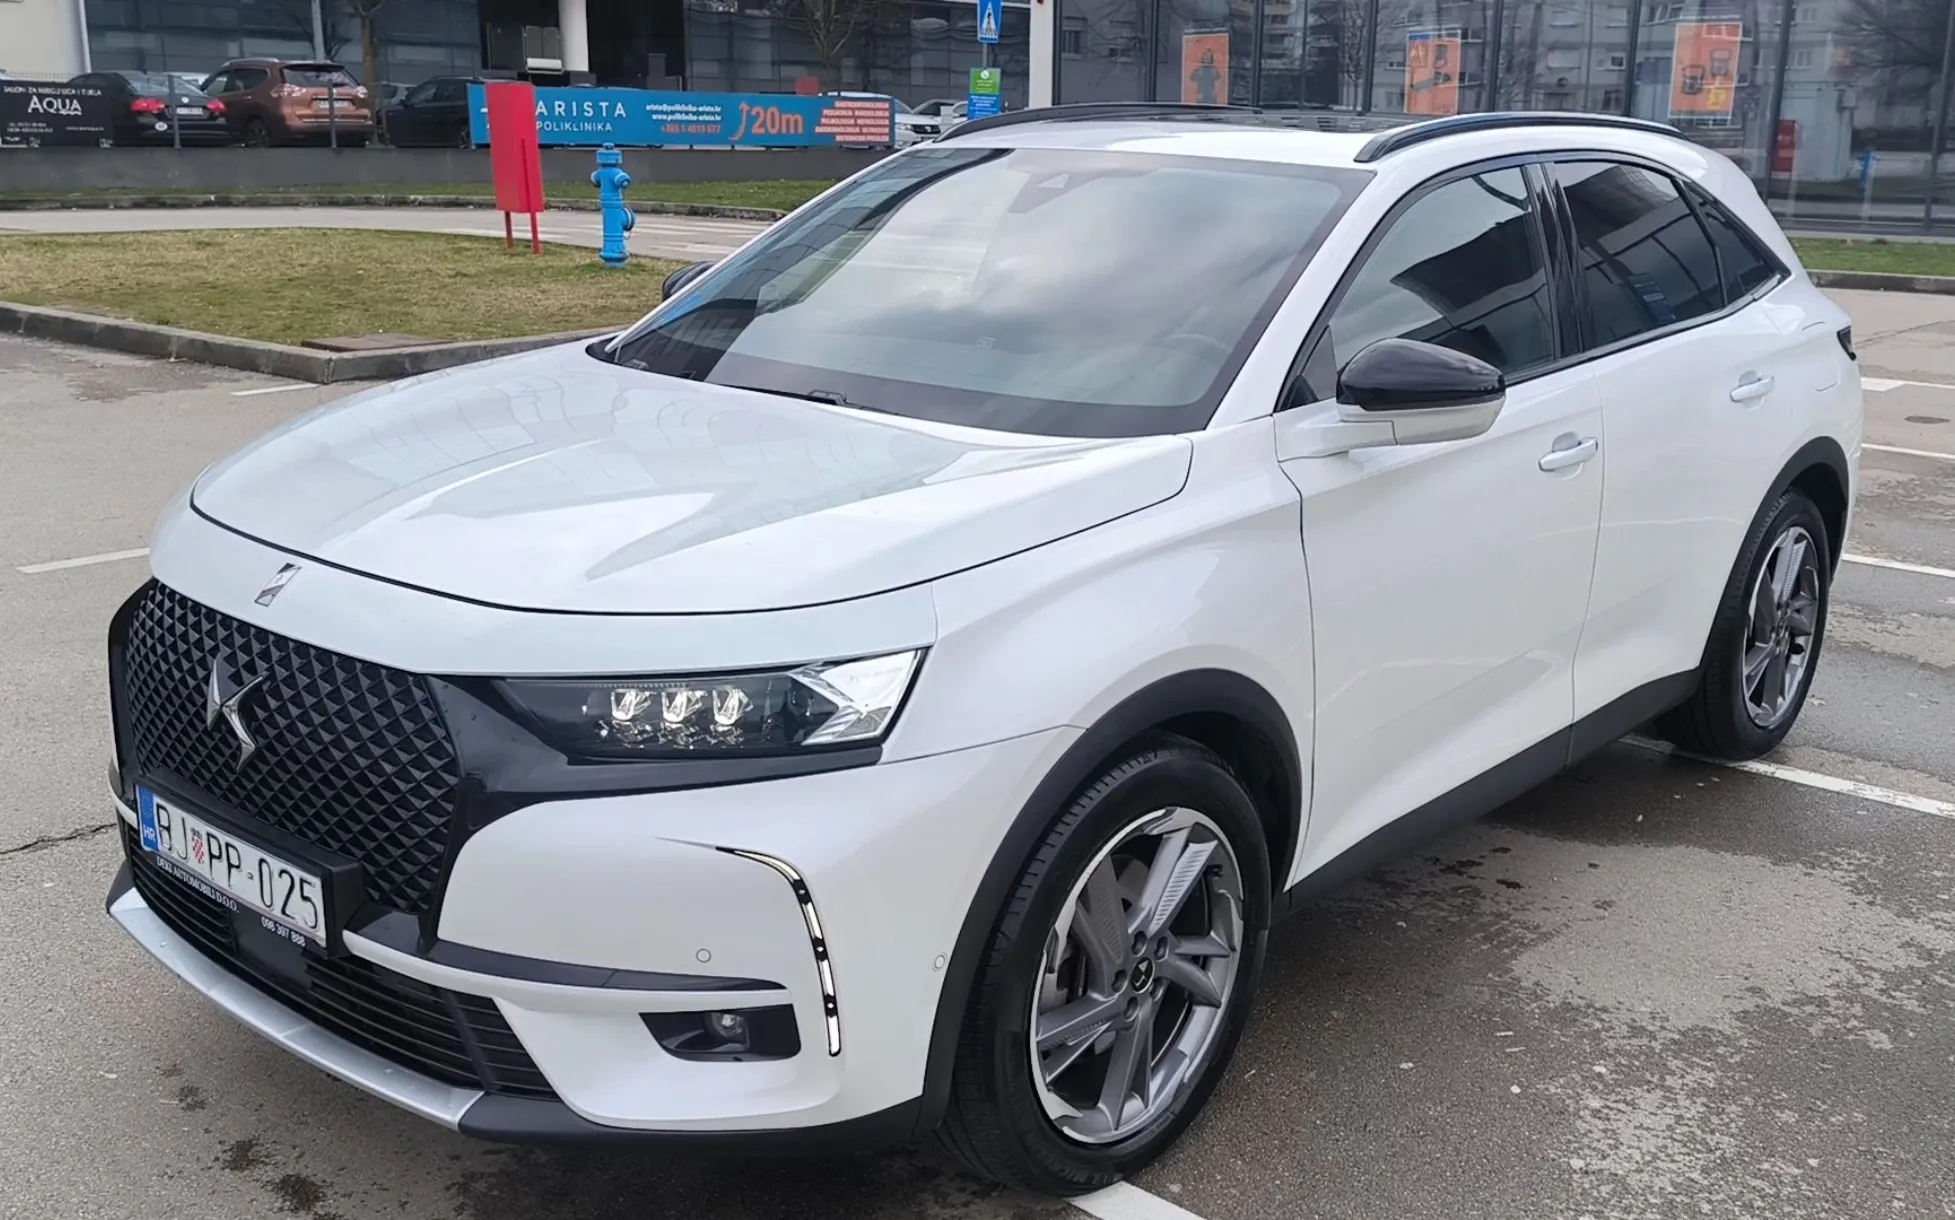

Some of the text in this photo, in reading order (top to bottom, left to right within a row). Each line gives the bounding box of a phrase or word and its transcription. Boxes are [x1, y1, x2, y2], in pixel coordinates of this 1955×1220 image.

[27, 95, 82, 115] AQUA
[535, 100, 626, 117] ARISTA
[536, 120, 613, 132] POLIKLINIKA
[751, 106, 803, 135] 20m
[143, 826, 157, 842] HR
[156, 803, 188, 860] BJ
